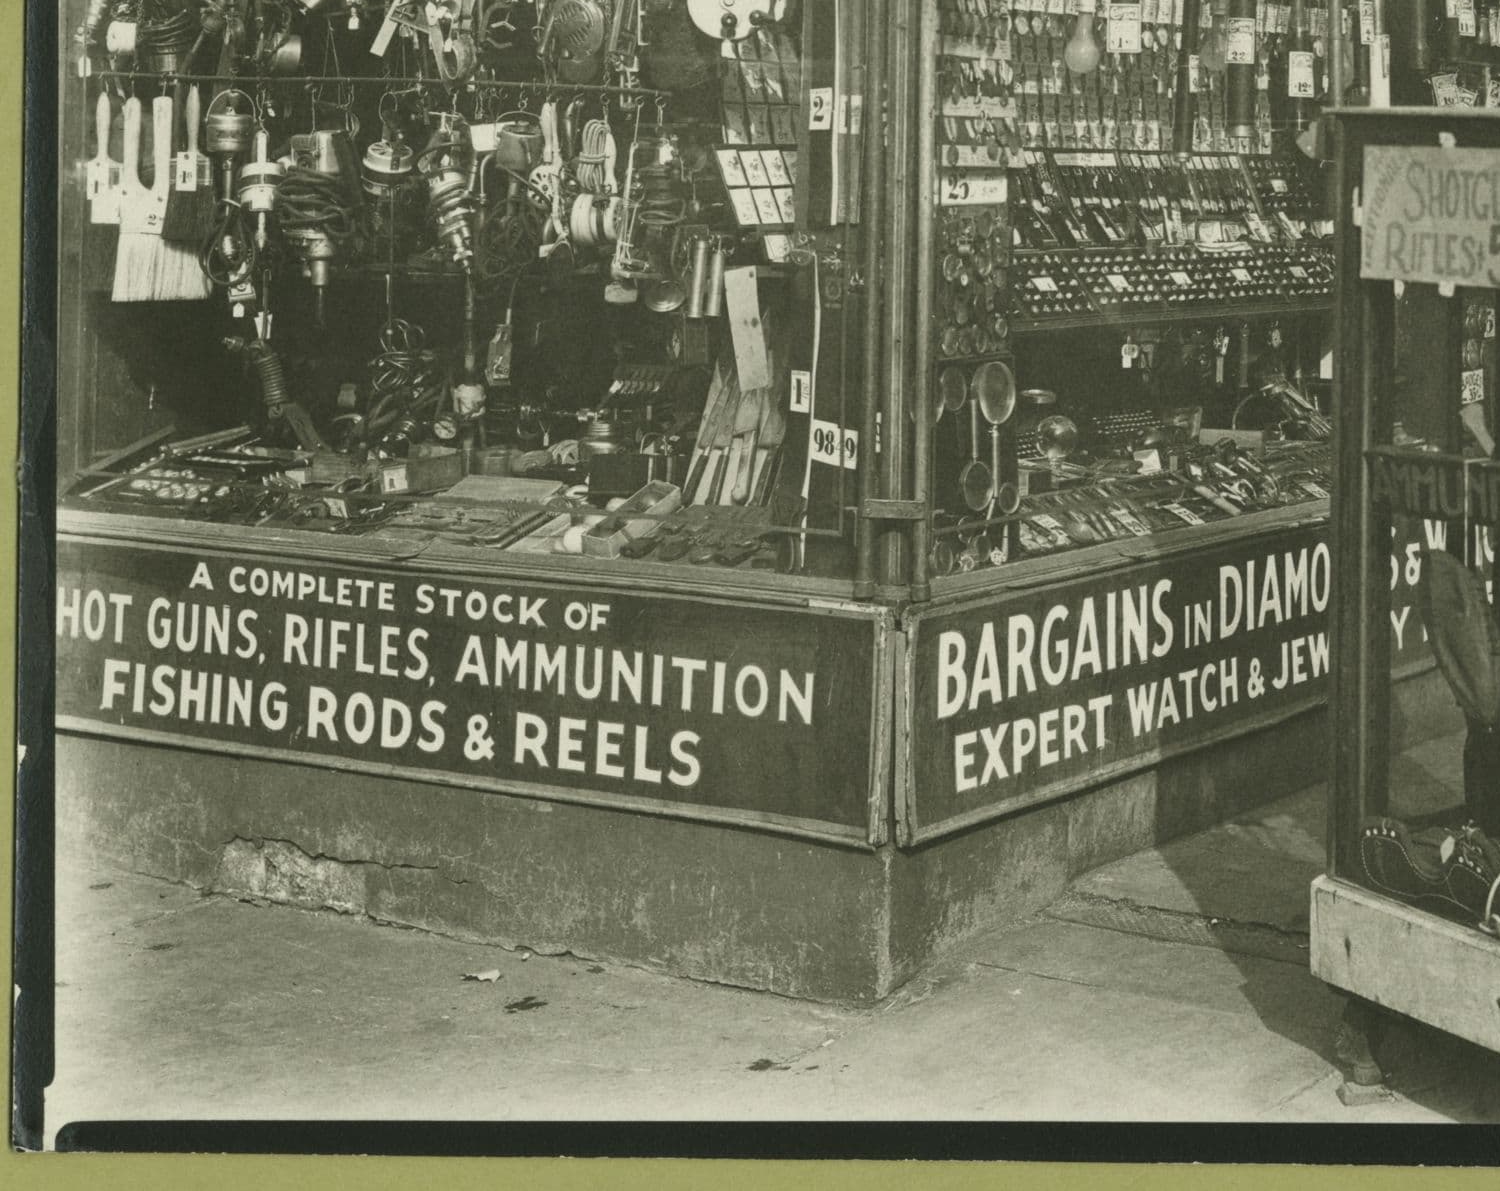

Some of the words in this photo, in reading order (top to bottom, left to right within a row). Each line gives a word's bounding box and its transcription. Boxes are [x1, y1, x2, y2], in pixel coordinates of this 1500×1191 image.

[1385, 221, 1476, 278] RIFLES
[189, 561, 215, 592] A
[229, 566, 395, 611] COMPLETE
[417, 584, 547, 628] STOCK
[564, 602, 611, 633] OF
[937, 578, 1174, 720] BARGAINS
[1185, 599, 1212, 648] IN
[1219, 542, 1331, 640] DIAMO
[100, 659, 289, 731] FISHING
[307, 686, 447, 754] RODS
[465, 714, 496, 762] &
[513, 712, 703, 787] REELS
[147, 599, 267, 665] GUNS,
[284, 612, 435, 689] RIFLES,
[455, 635, 816, 726] AMMUNITION
[954, 694, 1113, 794] EXPERT
[1127, 657, 1239, 739] WATCH
[1247, 658, 1265, 698] &
[1272, 631, 1331, 689] JEW
